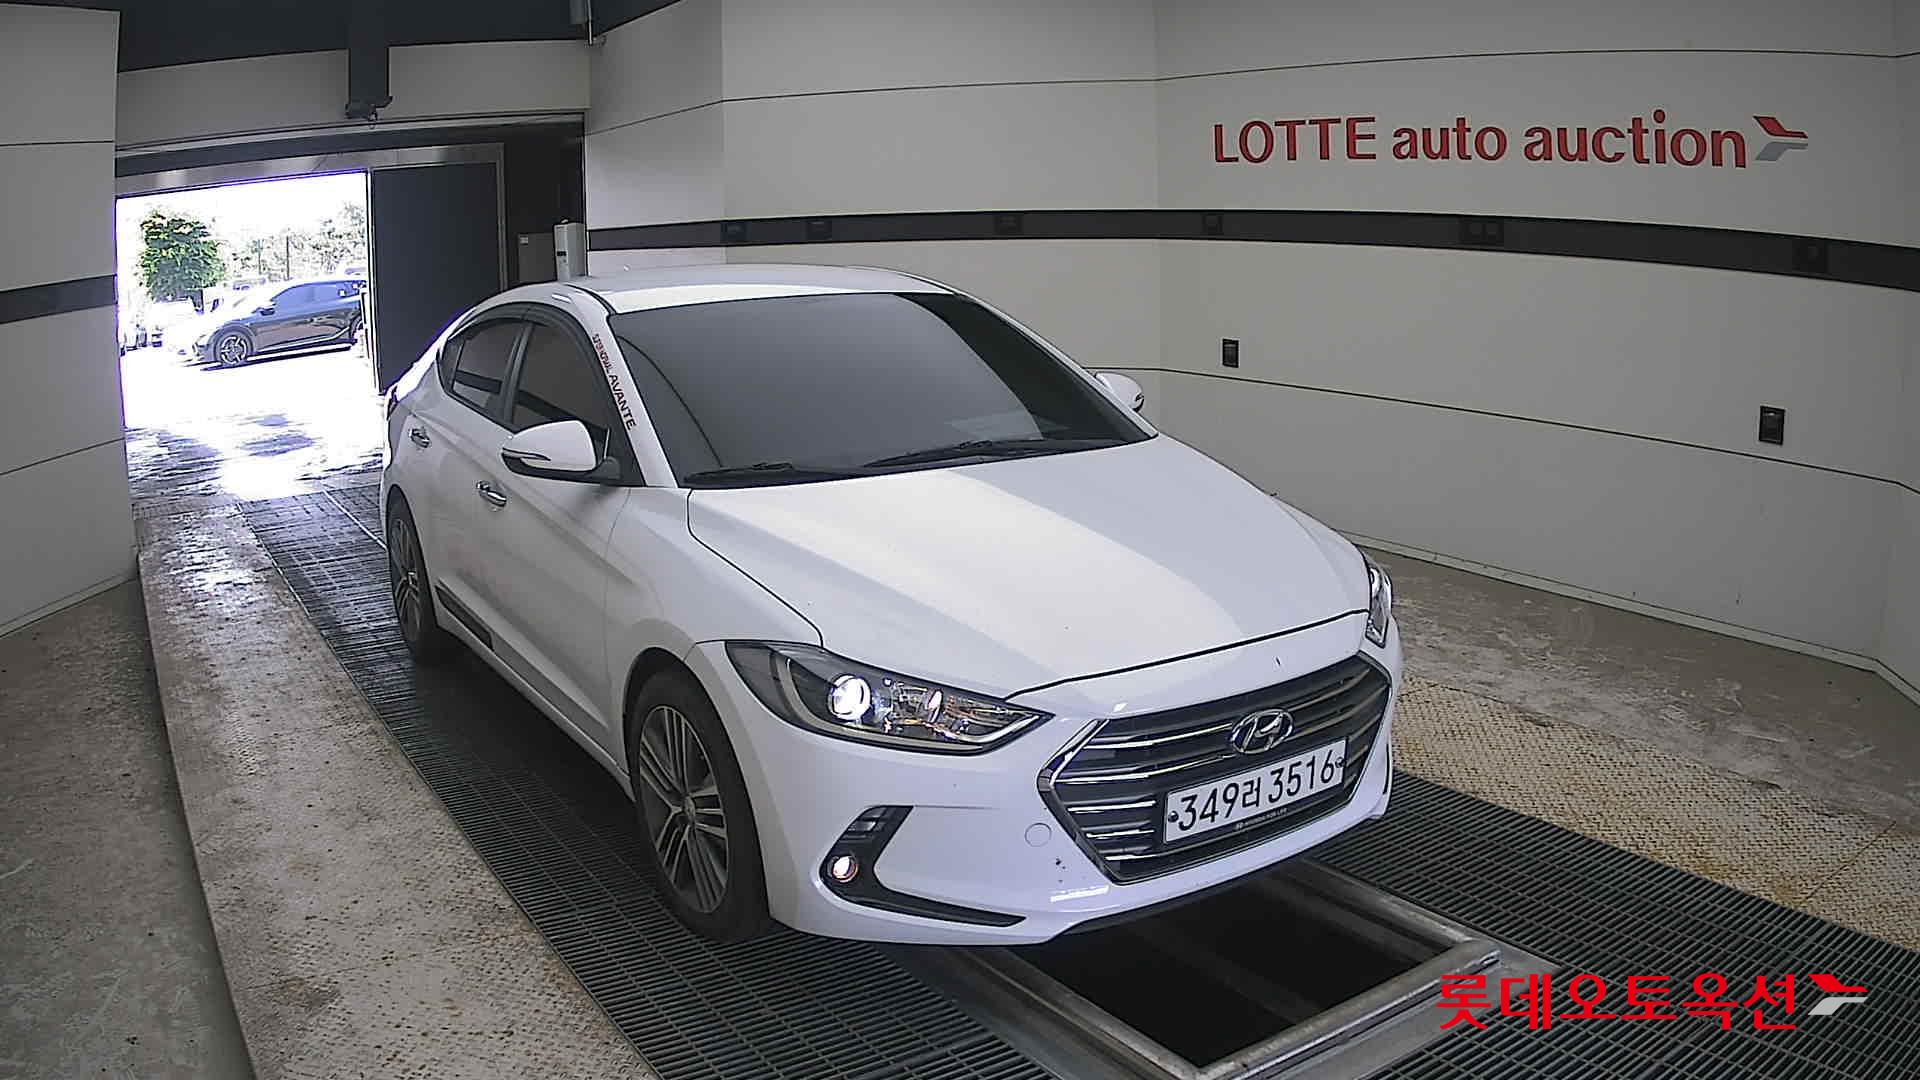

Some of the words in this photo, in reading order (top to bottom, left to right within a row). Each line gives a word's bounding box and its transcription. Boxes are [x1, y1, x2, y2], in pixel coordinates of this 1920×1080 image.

[1213, 116, 1377, 165] LOTTE
[1392, 117, 1508, 162] auto
[1523, 109, 1747, 168] auction
[608, 374, 637, 431] AVANTE
[1178, 776, 1261, 832] 349러
[1267, 750, 1336, 804] 3516
